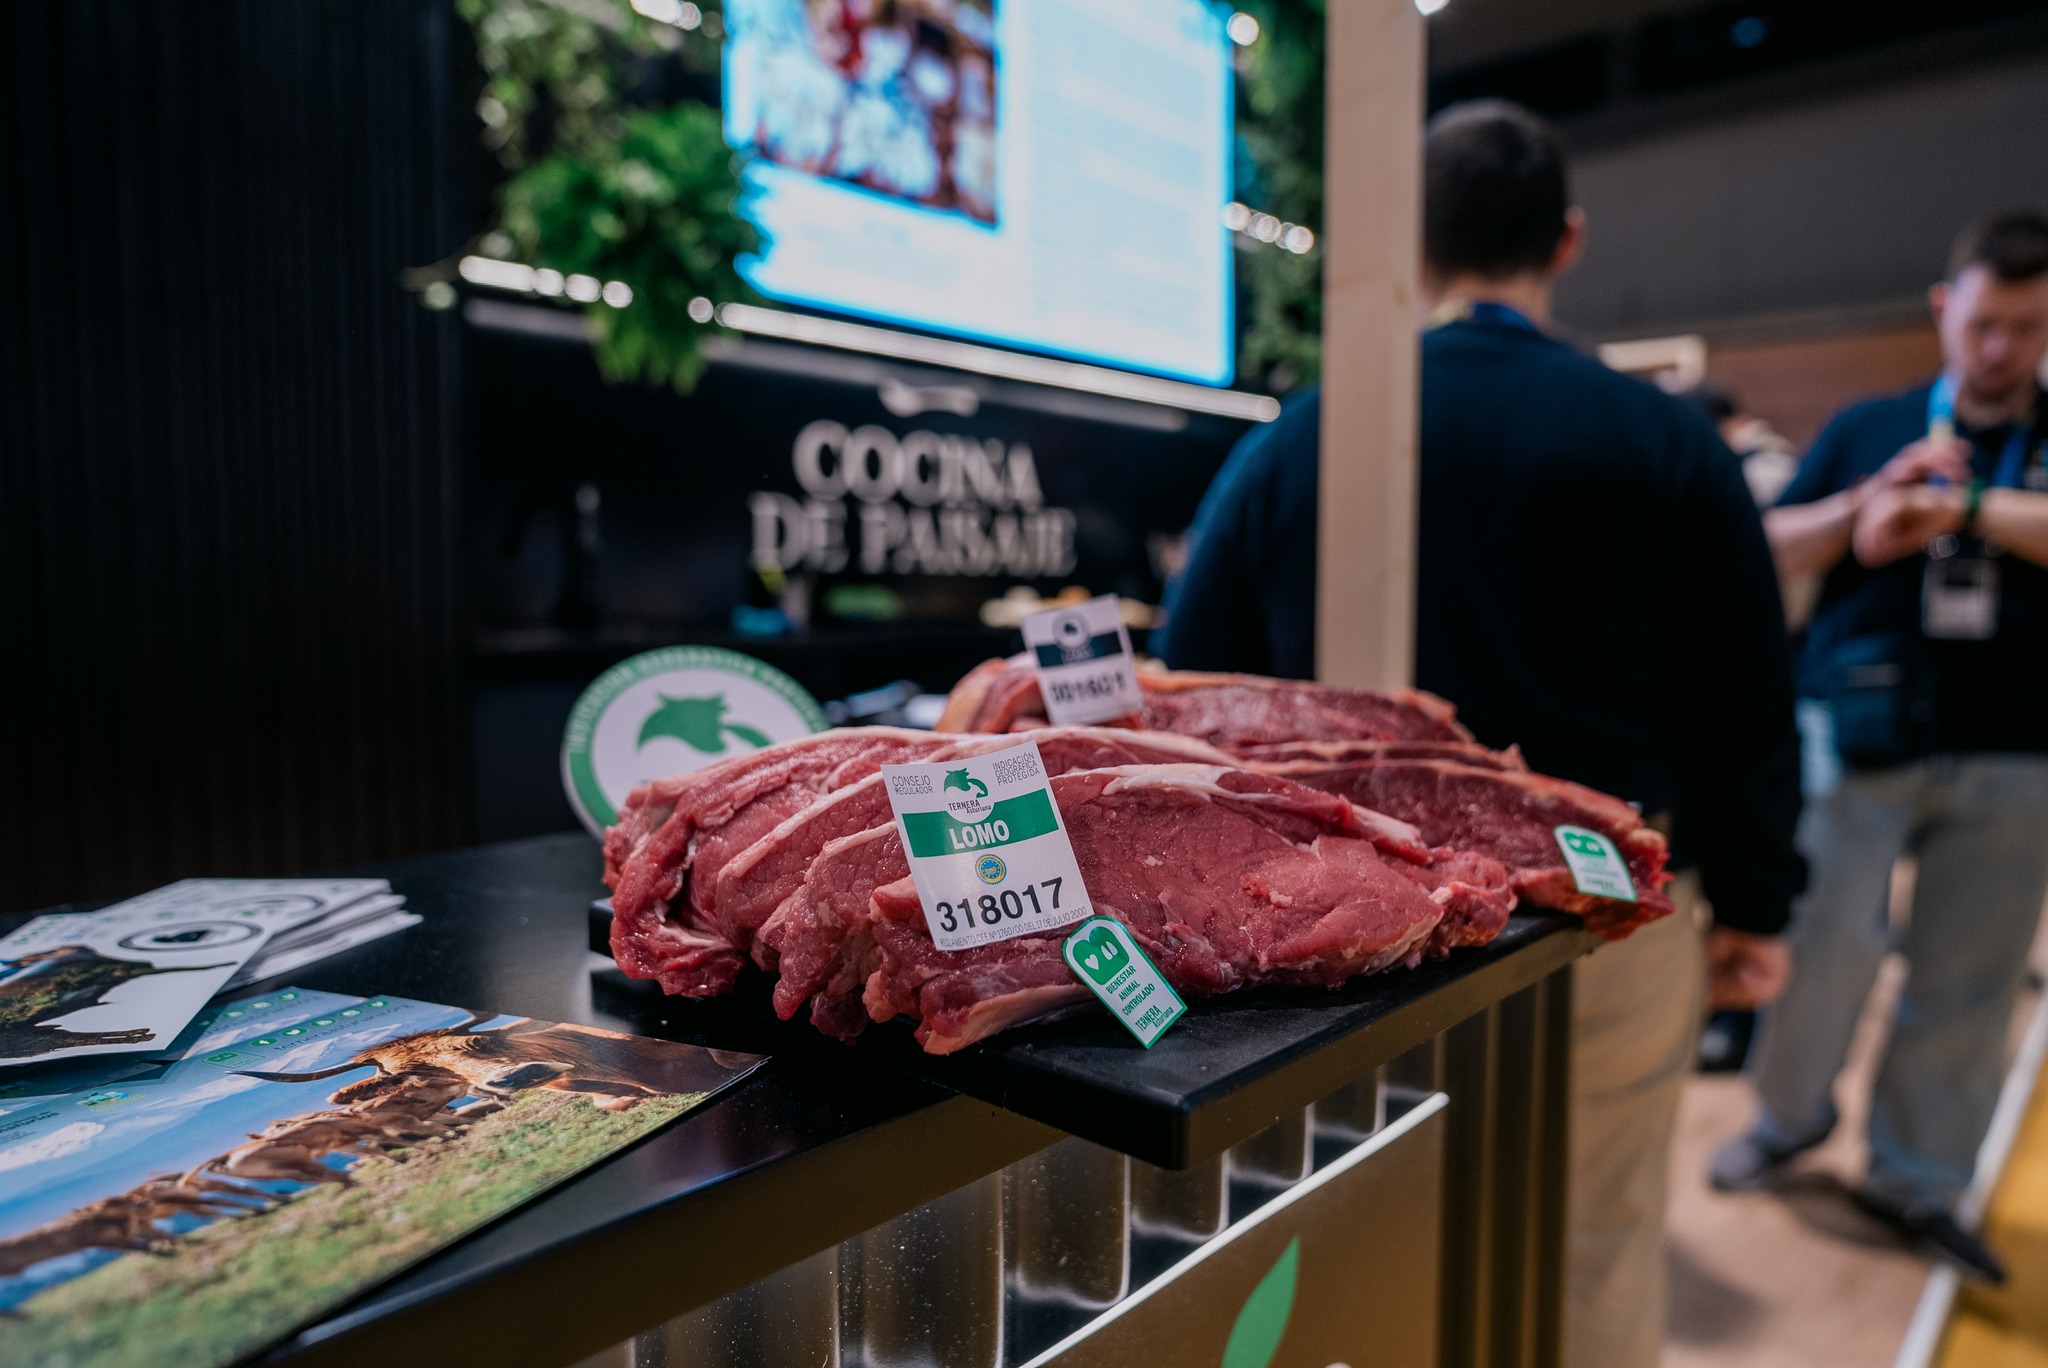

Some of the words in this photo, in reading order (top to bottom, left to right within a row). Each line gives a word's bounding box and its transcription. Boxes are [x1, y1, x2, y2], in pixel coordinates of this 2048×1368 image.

[793, 419, 1044, 512] COCINA
[749, 491, 849, 573] DE
[858, 498, 1078, 577] PAISAJE
[992, 752, 1035, 770] INDICACIÓN
[892, 775, 931, 787] CONSEJO
[997, 767, 1041, 786] PROTEGIDA
[894, 786, 934, 795] REGULADOR
[948, 799, 981, 811] TERNERA
[966, 804, 992, 814] Asturiana
[949, 820, 1010, 850] LOMO
[936, 876, 1063, 932] 318017
[976, 932, 989, 943] CEE
[1024, 921, 1036, 932] DEL
[1043, 918, 1052, 927] DE
[1053, 912, 1070, 926] JULIO
[1070, 906, 1088, 920] 2000
[1105, 965, 1136, 995] BIENESTAR
[1118, 980, 1140, 1001] ANIMAL
[1122, 983, 1155, 1016] CONTROLADO
[1135, 1005, 1162, 1031] TERNERA
